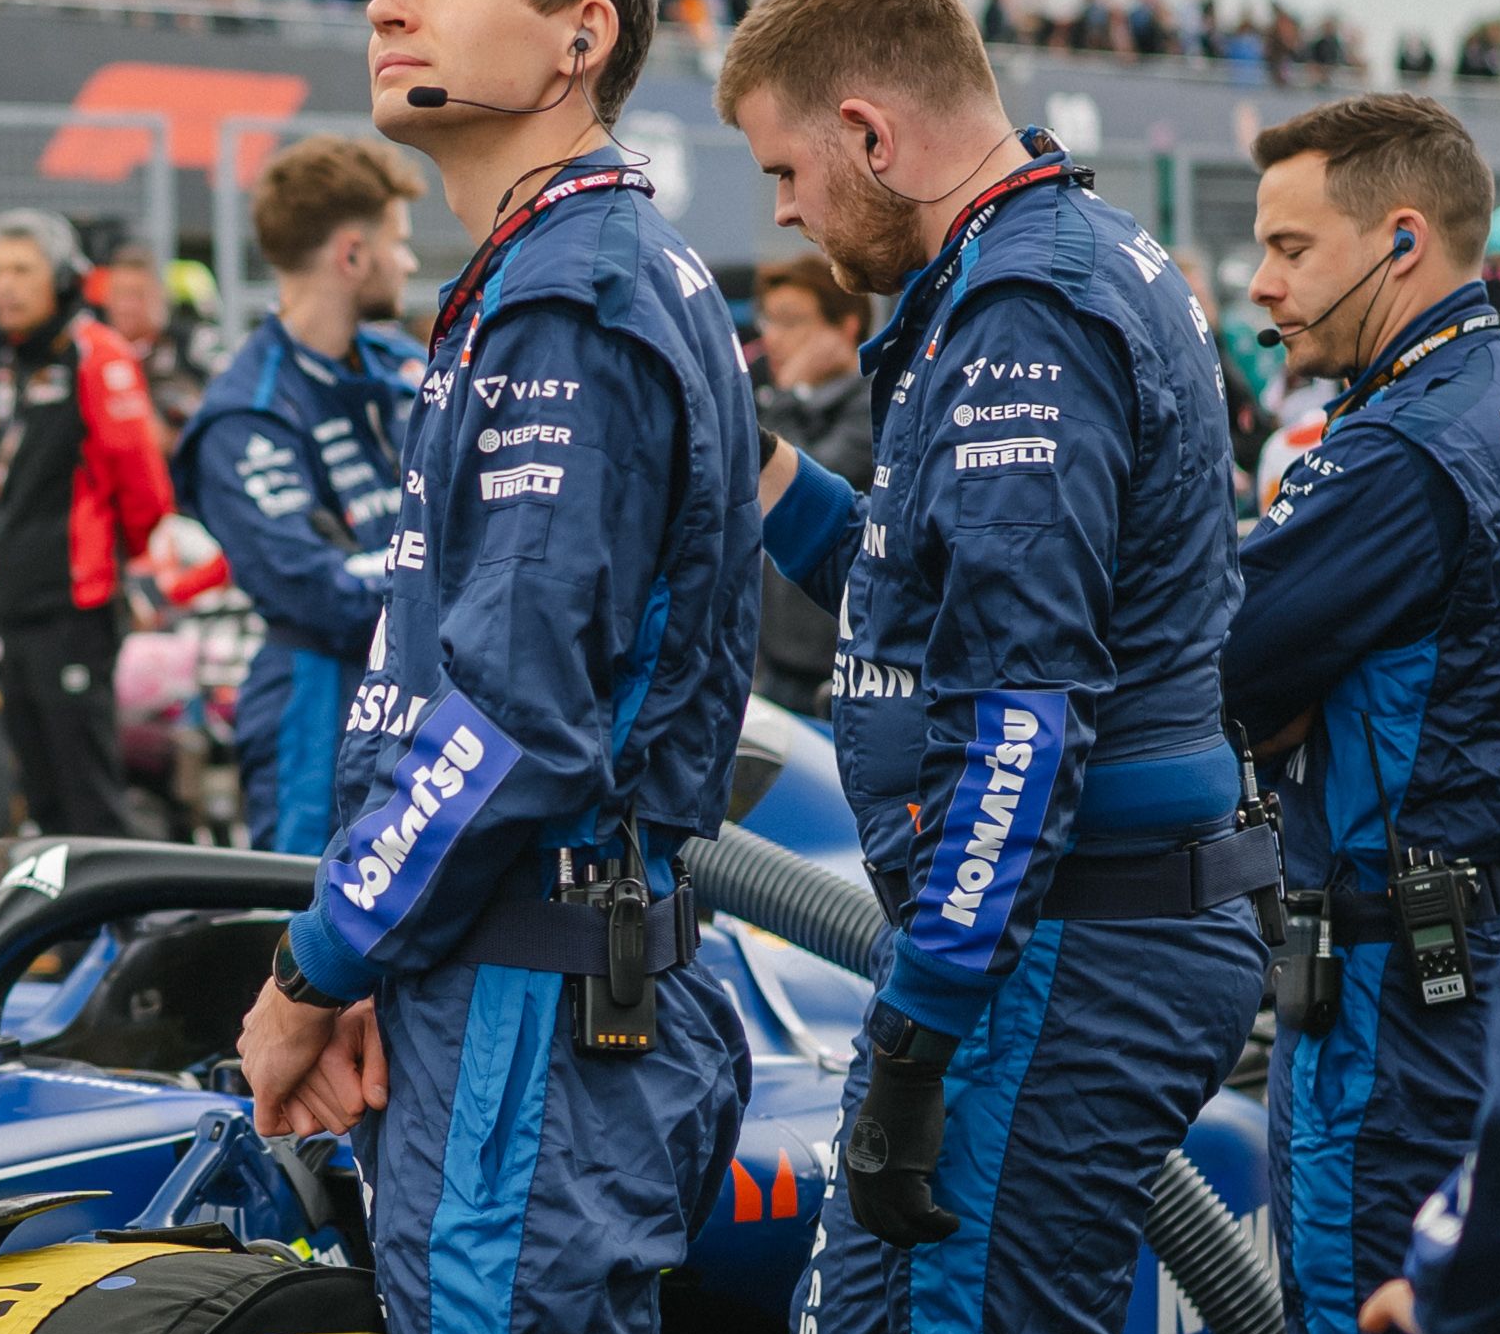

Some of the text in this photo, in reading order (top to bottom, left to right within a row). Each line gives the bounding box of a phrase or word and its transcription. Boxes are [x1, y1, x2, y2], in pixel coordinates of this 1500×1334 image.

[991, 363, 1062, 382] VAST
[511, 379, 579, 400] VAST
[976, 403, 1059, 422] KEEPER
[502, 424, 572, 447] KEEPER
[955, 436, 1058, 471] PIRELLI
[480, 462, 565, 501] PIRELLI
[941, 707, 1039, 928] KOMATSU
